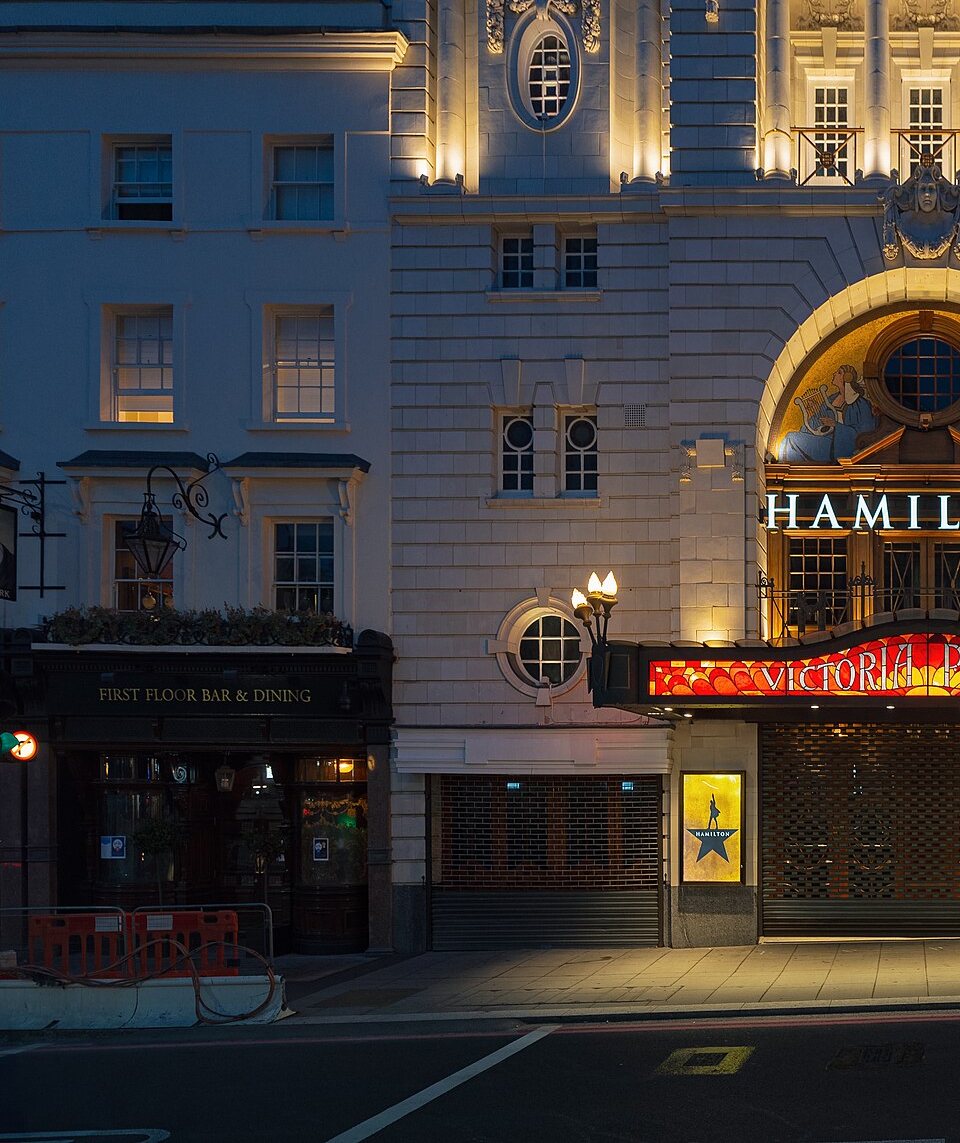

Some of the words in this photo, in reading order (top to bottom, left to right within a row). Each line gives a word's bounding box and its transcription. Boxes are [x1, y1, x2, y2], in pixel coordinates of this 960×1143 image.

[761, 643, 913, 691] VICTORIA
[99, 688, 140, 701] FIRST
[146, 688, 197, 702] FLOOR
[202, 689, 232, 702] BAR
[236, 690, 248, 702] &
[254, 689, 311, 703] DINING
